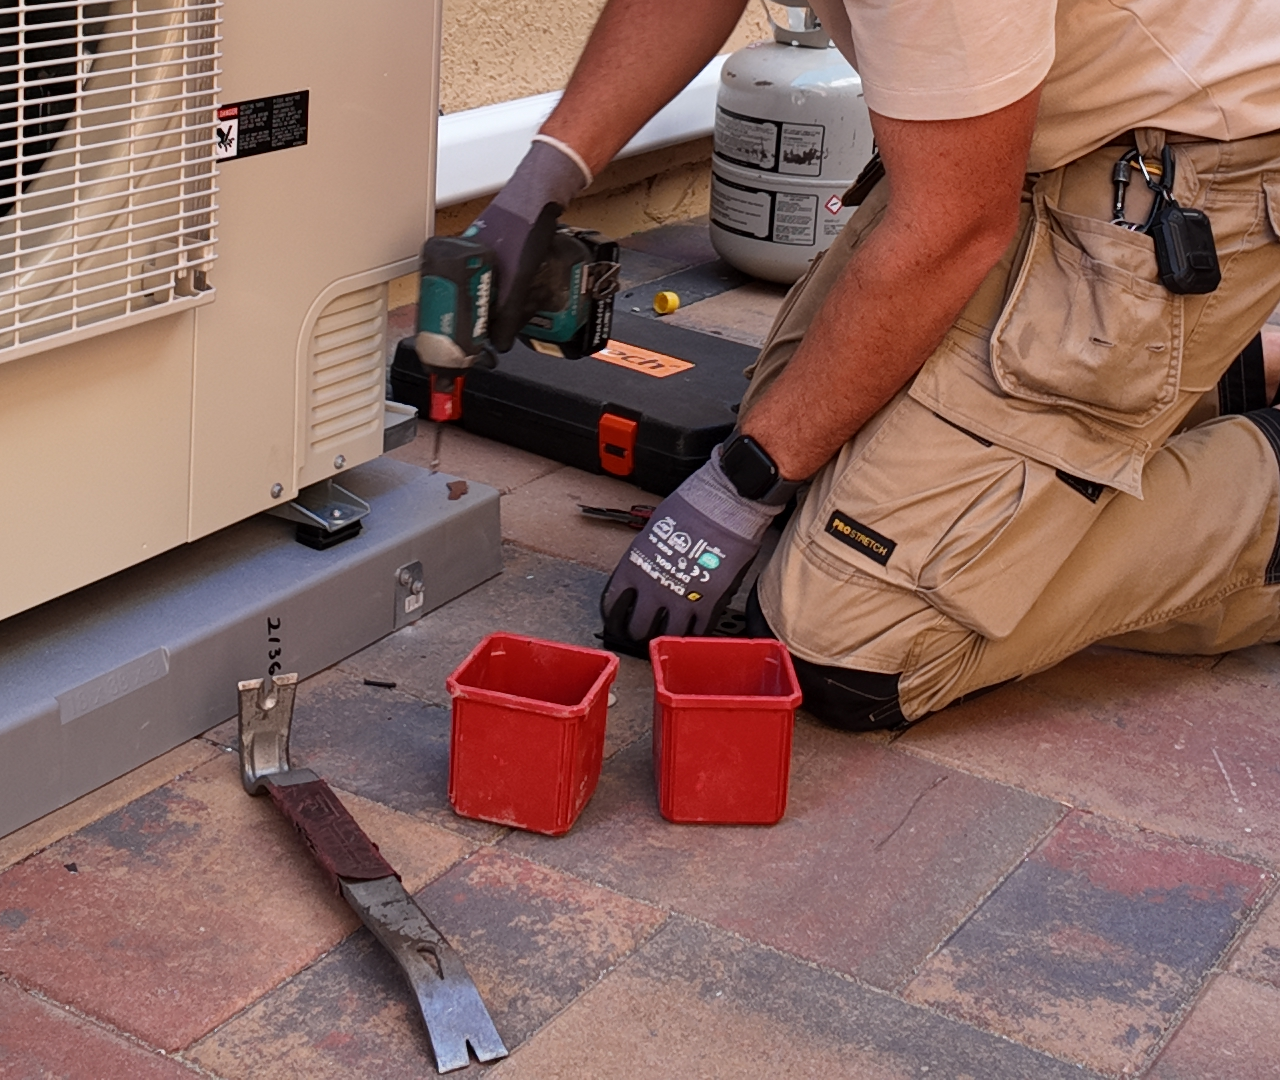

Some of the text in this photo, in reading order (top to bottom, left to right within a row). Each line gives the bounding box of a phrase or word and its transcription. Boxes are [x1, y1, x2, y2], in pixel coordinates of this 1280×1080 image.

[832, 518, 888, 556] PRO STRETCH
[267, 616, 282, 676] 2136
